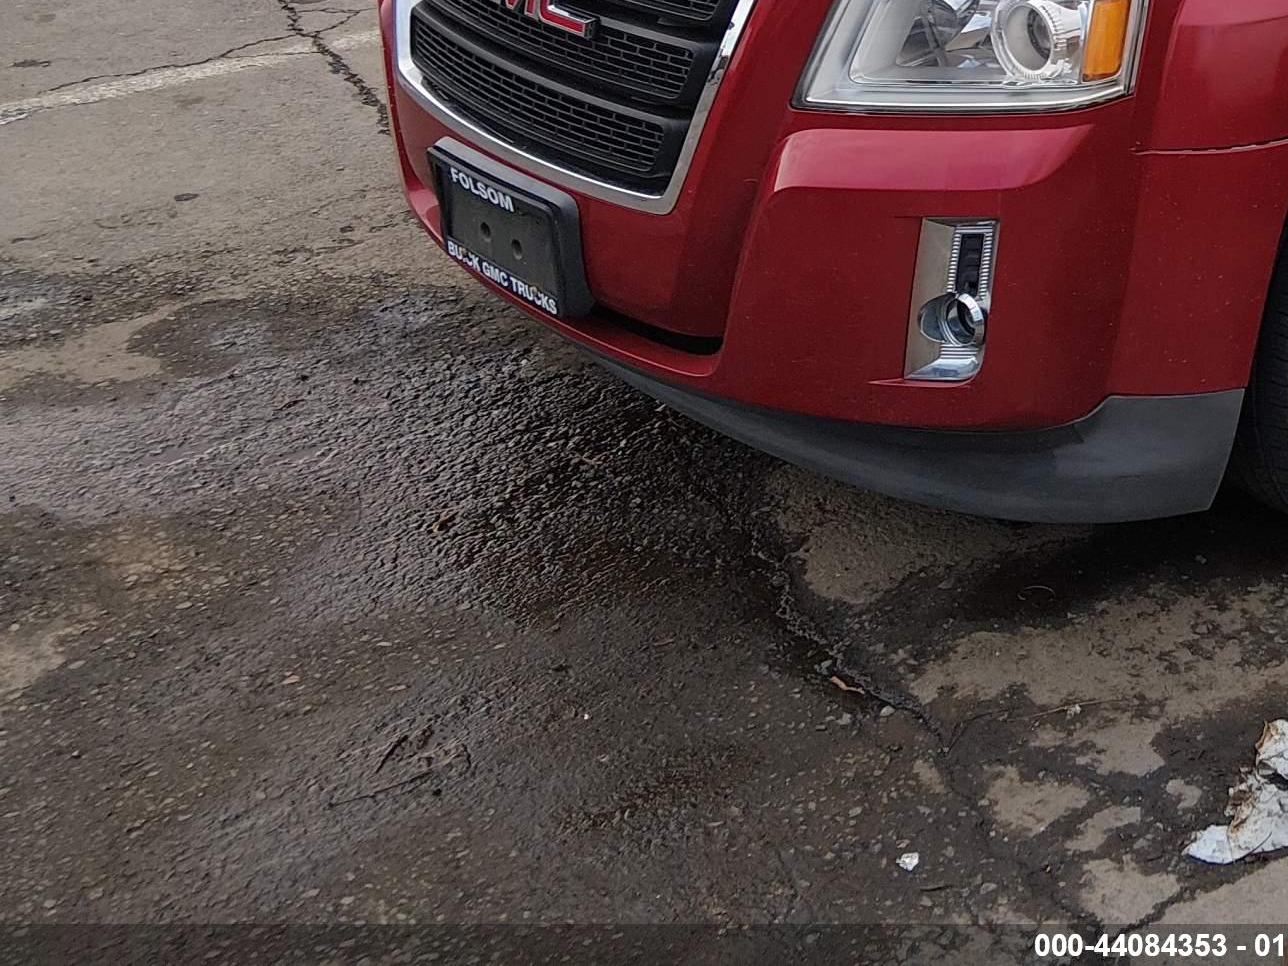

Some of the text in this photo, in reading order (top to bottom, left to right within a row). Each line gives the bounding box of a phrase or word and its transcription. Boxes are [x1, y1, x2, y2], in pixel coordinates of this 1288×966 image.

[450, 166, 515, 212] FOLSOM
[447, 240, 481, 272] BUCK
[482, 261, 510, 287] GMC
